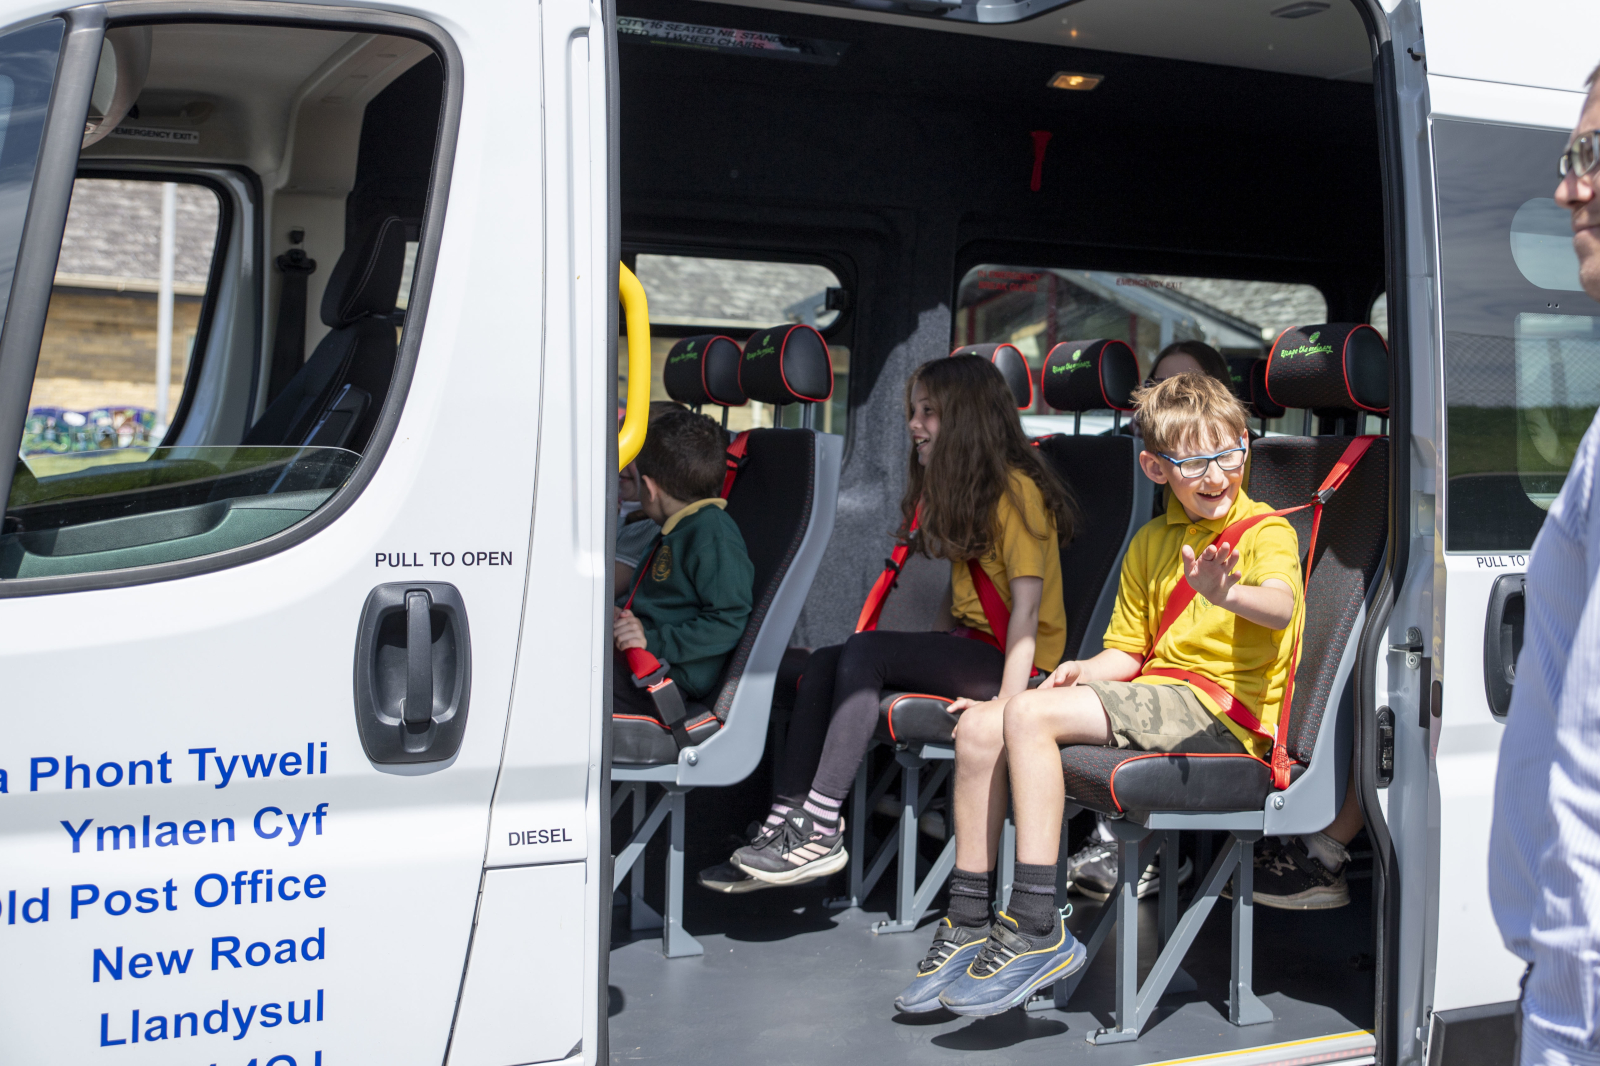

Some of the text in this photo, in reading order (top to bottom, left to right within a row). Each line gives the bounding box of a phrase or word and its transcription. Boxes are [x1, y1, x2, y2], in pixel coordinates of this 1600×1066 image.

[650, 21, 663, 30] 16
[665, 23, 716, 36] SEATED
[718, 29, 736, 38] NIL
[674, 33, 765, 49] WHEELCHAIRS
[115, 127, 192, 140] EMERGENCY EXIT
[1116, 277, 1183, 290] EMERGENCY EXIT
[375, 551, 513, 567] PULL TO OPEN
[1476, 556, 1507, 568] PULL
[1509, 555, 1526, 566] TO
[30, 751, 173, 792] Phont
[188, 741, 328, 789] Tyweli
[60, 803, 330, 854] Ymlaen Cyf
[508, 828, 573, 846] DIESEL
[0, 868, 327, 925] ld Post Office
[93, 927, 326, 983] New Road
[100, 988, 324, 1047] Llandysul
